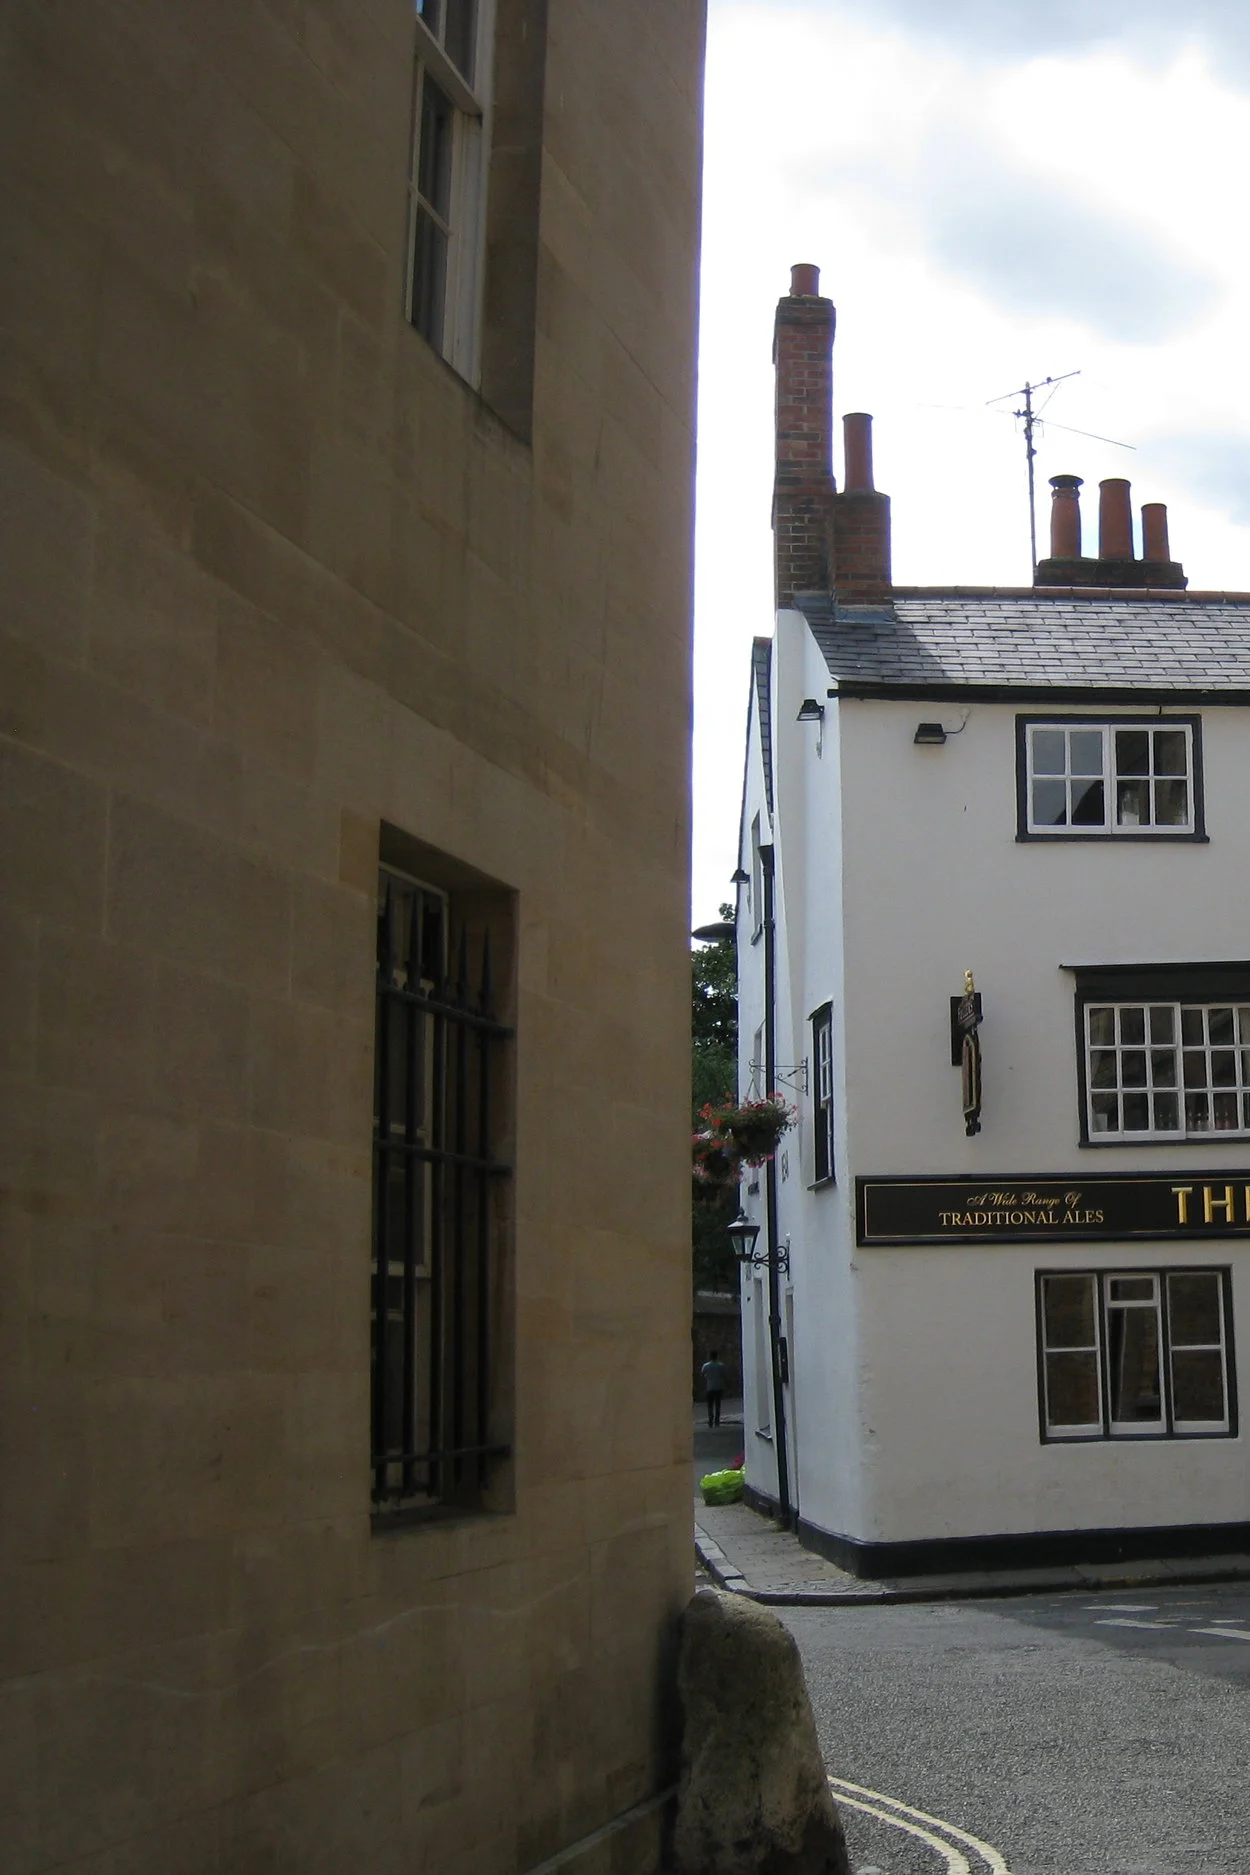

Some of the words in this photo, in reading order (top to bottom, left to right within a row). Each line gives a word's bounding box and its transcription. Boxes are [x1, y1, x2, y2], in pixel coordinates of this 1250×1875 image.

[966, 1192, 987, 1206] A
[988, 1192, 1017, 1206] Wide
[1021, 1191, 1060, 1209] Range
[1063, 1190, 1082, 1208] Of
[938, 1211, 1059, 1226] TRADITIONAL
[1062, 1209, 1104, 1224] ALES
